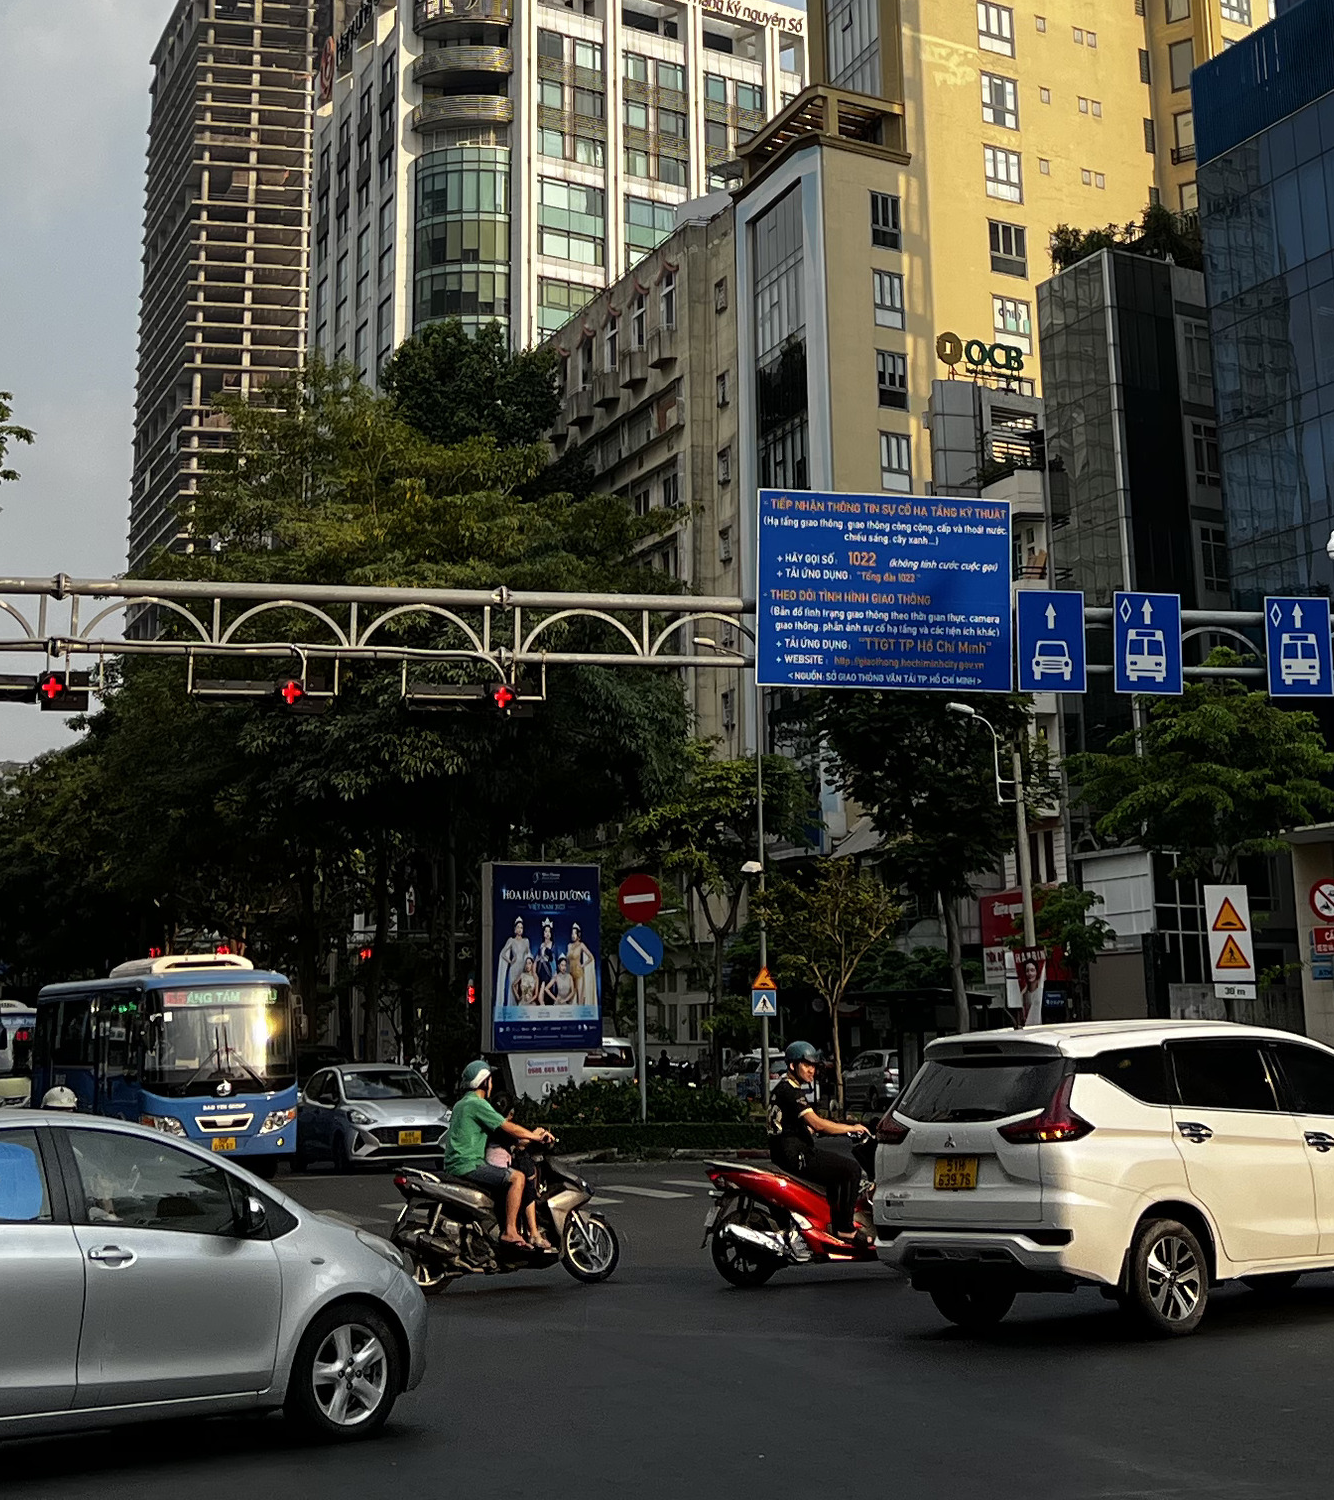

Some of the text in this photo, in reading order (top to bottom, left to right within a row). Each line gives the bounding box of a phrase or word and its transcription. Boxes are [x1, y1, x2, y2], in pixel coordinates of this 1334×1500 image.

[788, 17, 804, 34] Số
[964, 339, 1024, 371] OCB
[771, 495, 793, 510] TIẾP
[795, 499, 825, 514] NHẬN
[827, 500, 861, 513] THÔNG
[863, 502, 880, 513] TIN
[882, 504, 897, 517] SỰ
[898, 502, 912, 516] CỐ
[913, 505, 928, 519] HẠ
[930, 503, 957, 517] TẦNG
[800, 519, 818, 529] giao
[847, 521, 865, 530] giao
[866, 520, 890, 532] thông
[891, 521, 912, 533] công
[936, 522, 952, 534] cấp
[953, 524, 963, 533] và
[892, 534, 907, 546] cây
[805, 554, 820, 566] GỌI
[848, 551, 877, 566] 1022
[801, 567, 821, 579] ỨNG
[770, 589, 797, 601] THEO
[818, 588, 843, 602] TÌNH
[871, 593, 895, 604] GIAO
[897, 592, 931, 606] THÔNG
[822, 608, 845, 620] trạng
[847, 611, 864, 620] giao
[865, 609, 889, 622] thông
[890, 611, 909, 620] theo
[969, 615, 1000, 624] camera
[775, 622, 793, 632] giao
[863, 624, 874, 634] sự
[887, 623, 898, 636] hạ
[919, 625, 929, 634] và
[930, 625, 945, 635] các
[800, 636, 821, 649] ỨNG
[898, 639, 915, 652] TP
[917, 638, 934, 653] Hồ
[936, 640, 955, 653] Chí
[826, 669, 837, 681] SỞ
[838, 673, 856, 681] GIAO
[858, 672, 884, 682] THÔNG
[886, 672, 902, 684] VẬN
[941, 673, 955, 684] CHÍ
[956, 676, 976, 685] MINH
